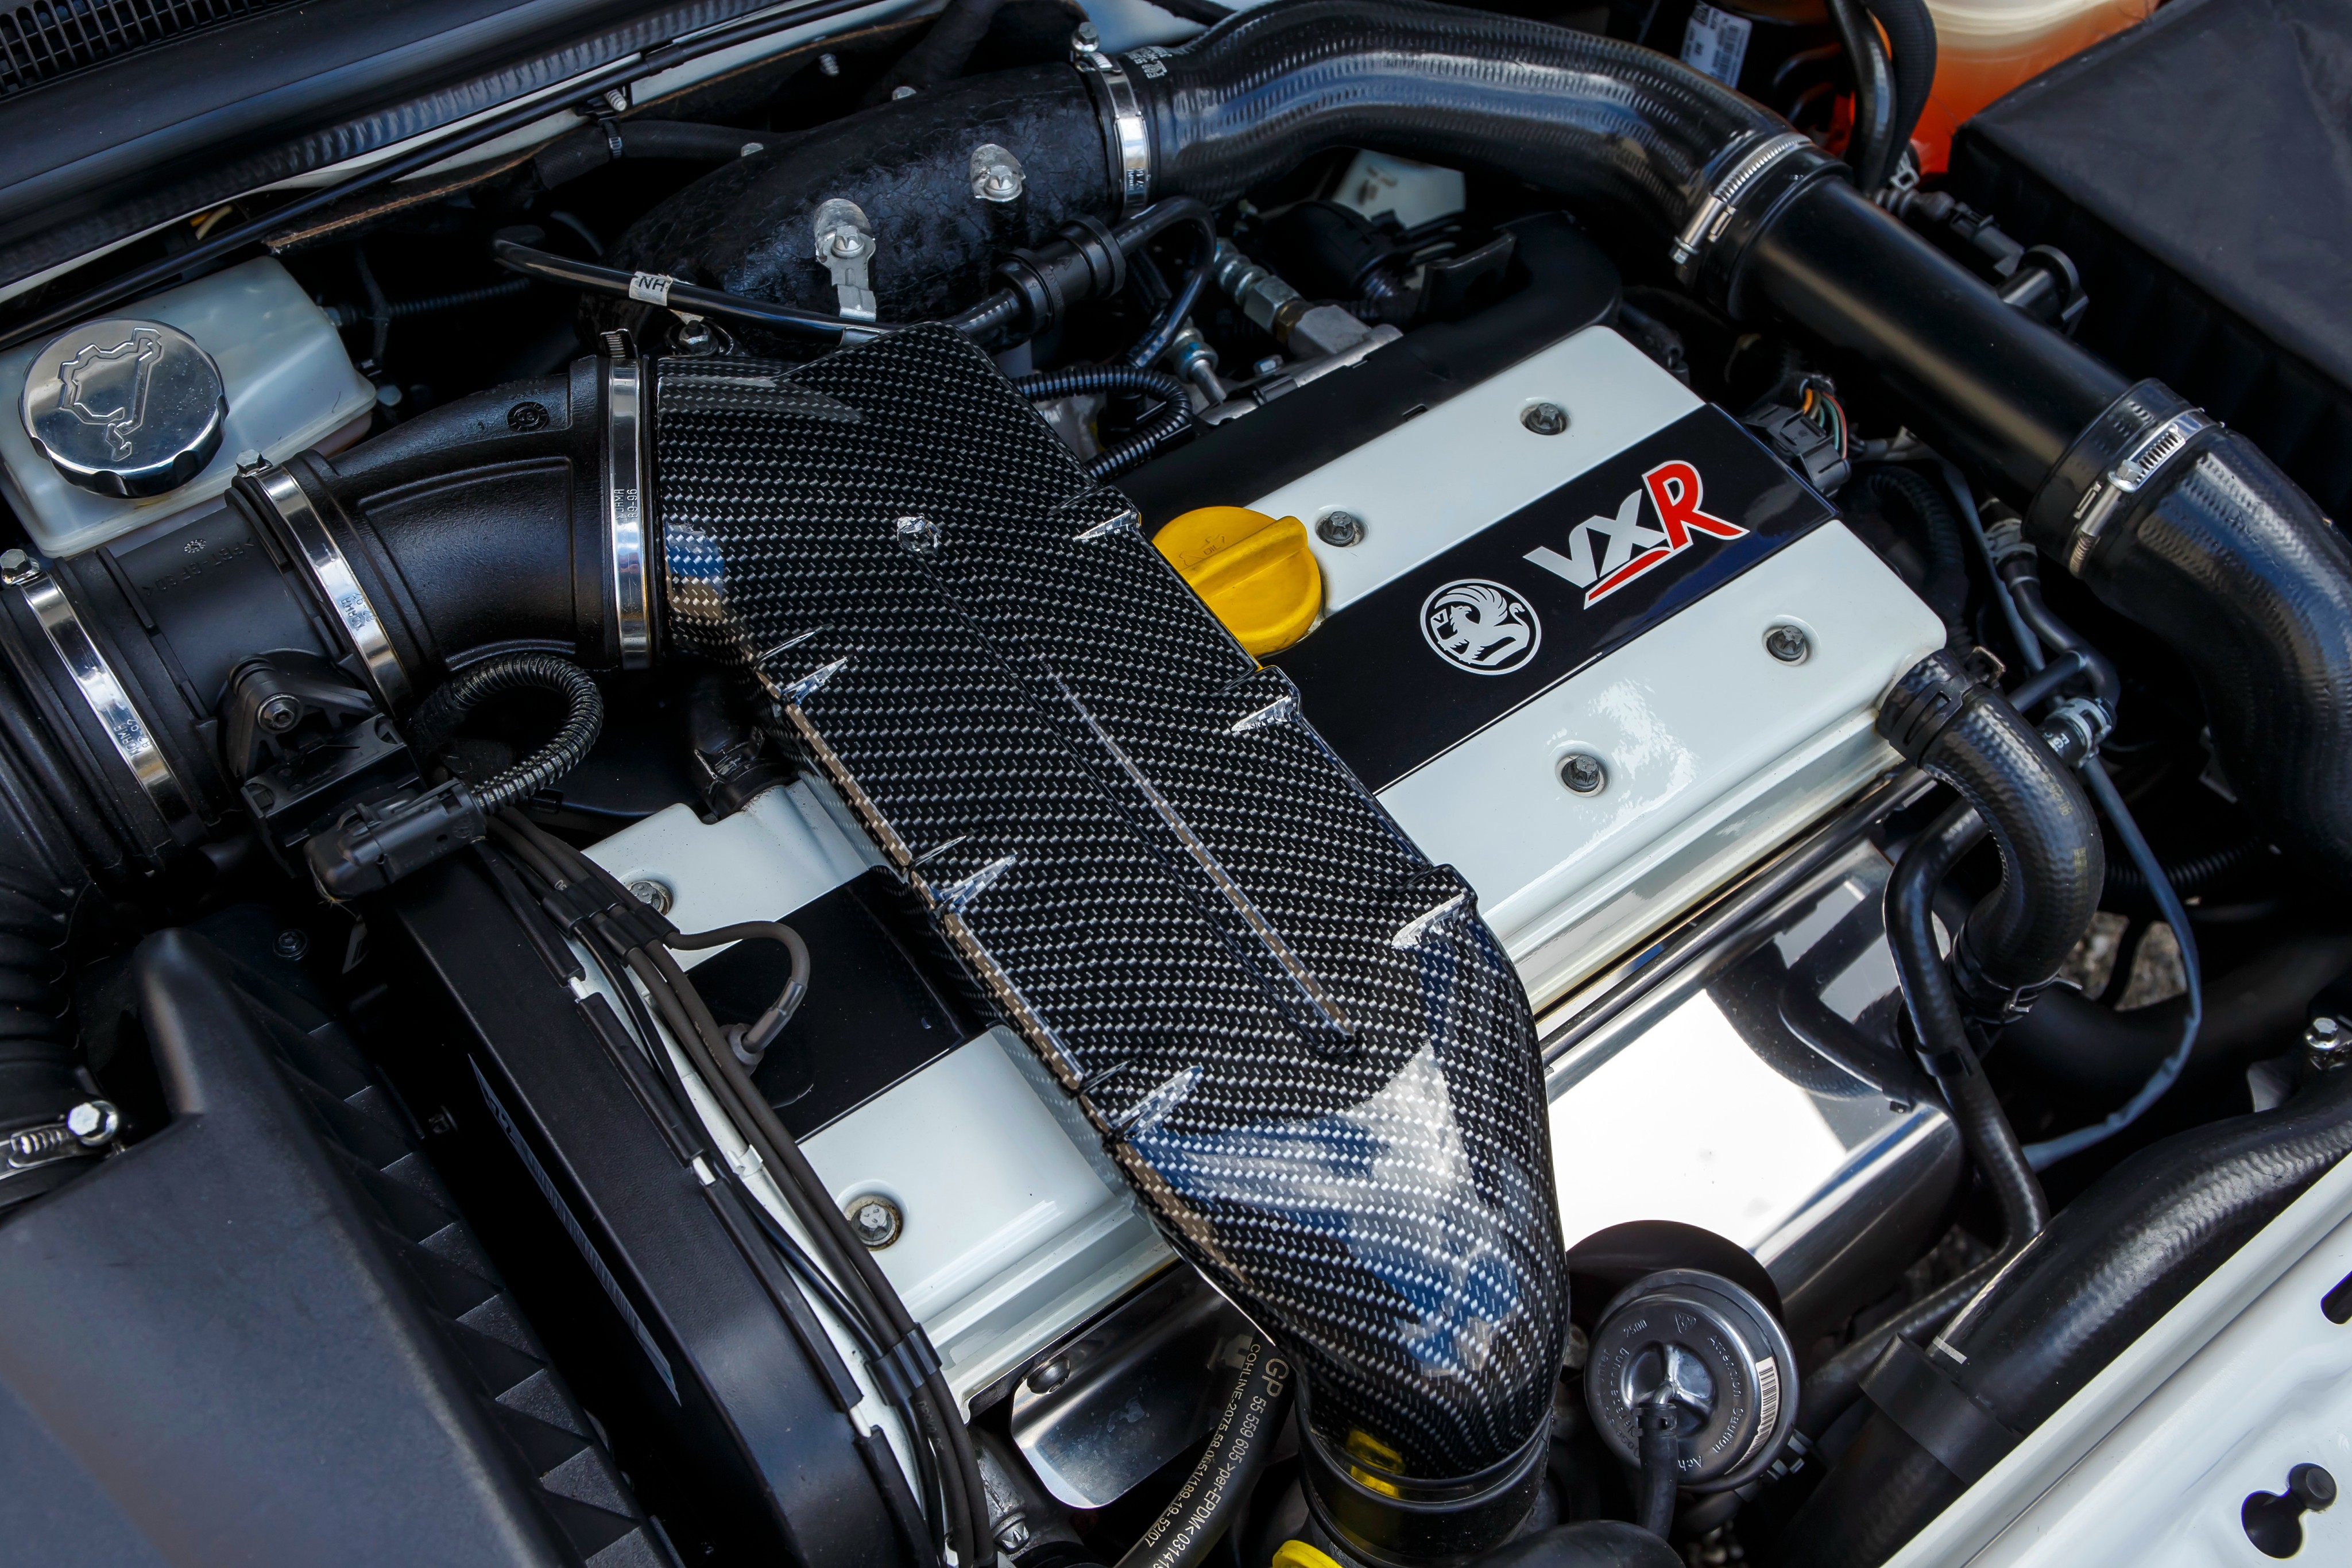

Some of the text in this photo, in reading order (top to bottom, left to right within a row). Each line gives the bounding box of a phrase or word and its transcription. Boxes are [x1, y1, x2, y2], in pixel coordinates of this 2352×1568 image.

[638, 276, 667, 292] NH
[613, 488, 626, 520] NORMA
[626, 489, 639, 518] 89-96
[1523, 460, 1750, 589] VXR
[1203, 544, 1221, 555] OIL
[1623, 1319, 1647, 1338] 2500
[1262, 1358, 1290, 1397] GP
[1250, 1395, 1267, 1414] 55
[1240, 1413, 1260, 1438] 559
[1712, 1407, 1744, 1454] Caution
[1228, 1438, 1250, 1464] 605
